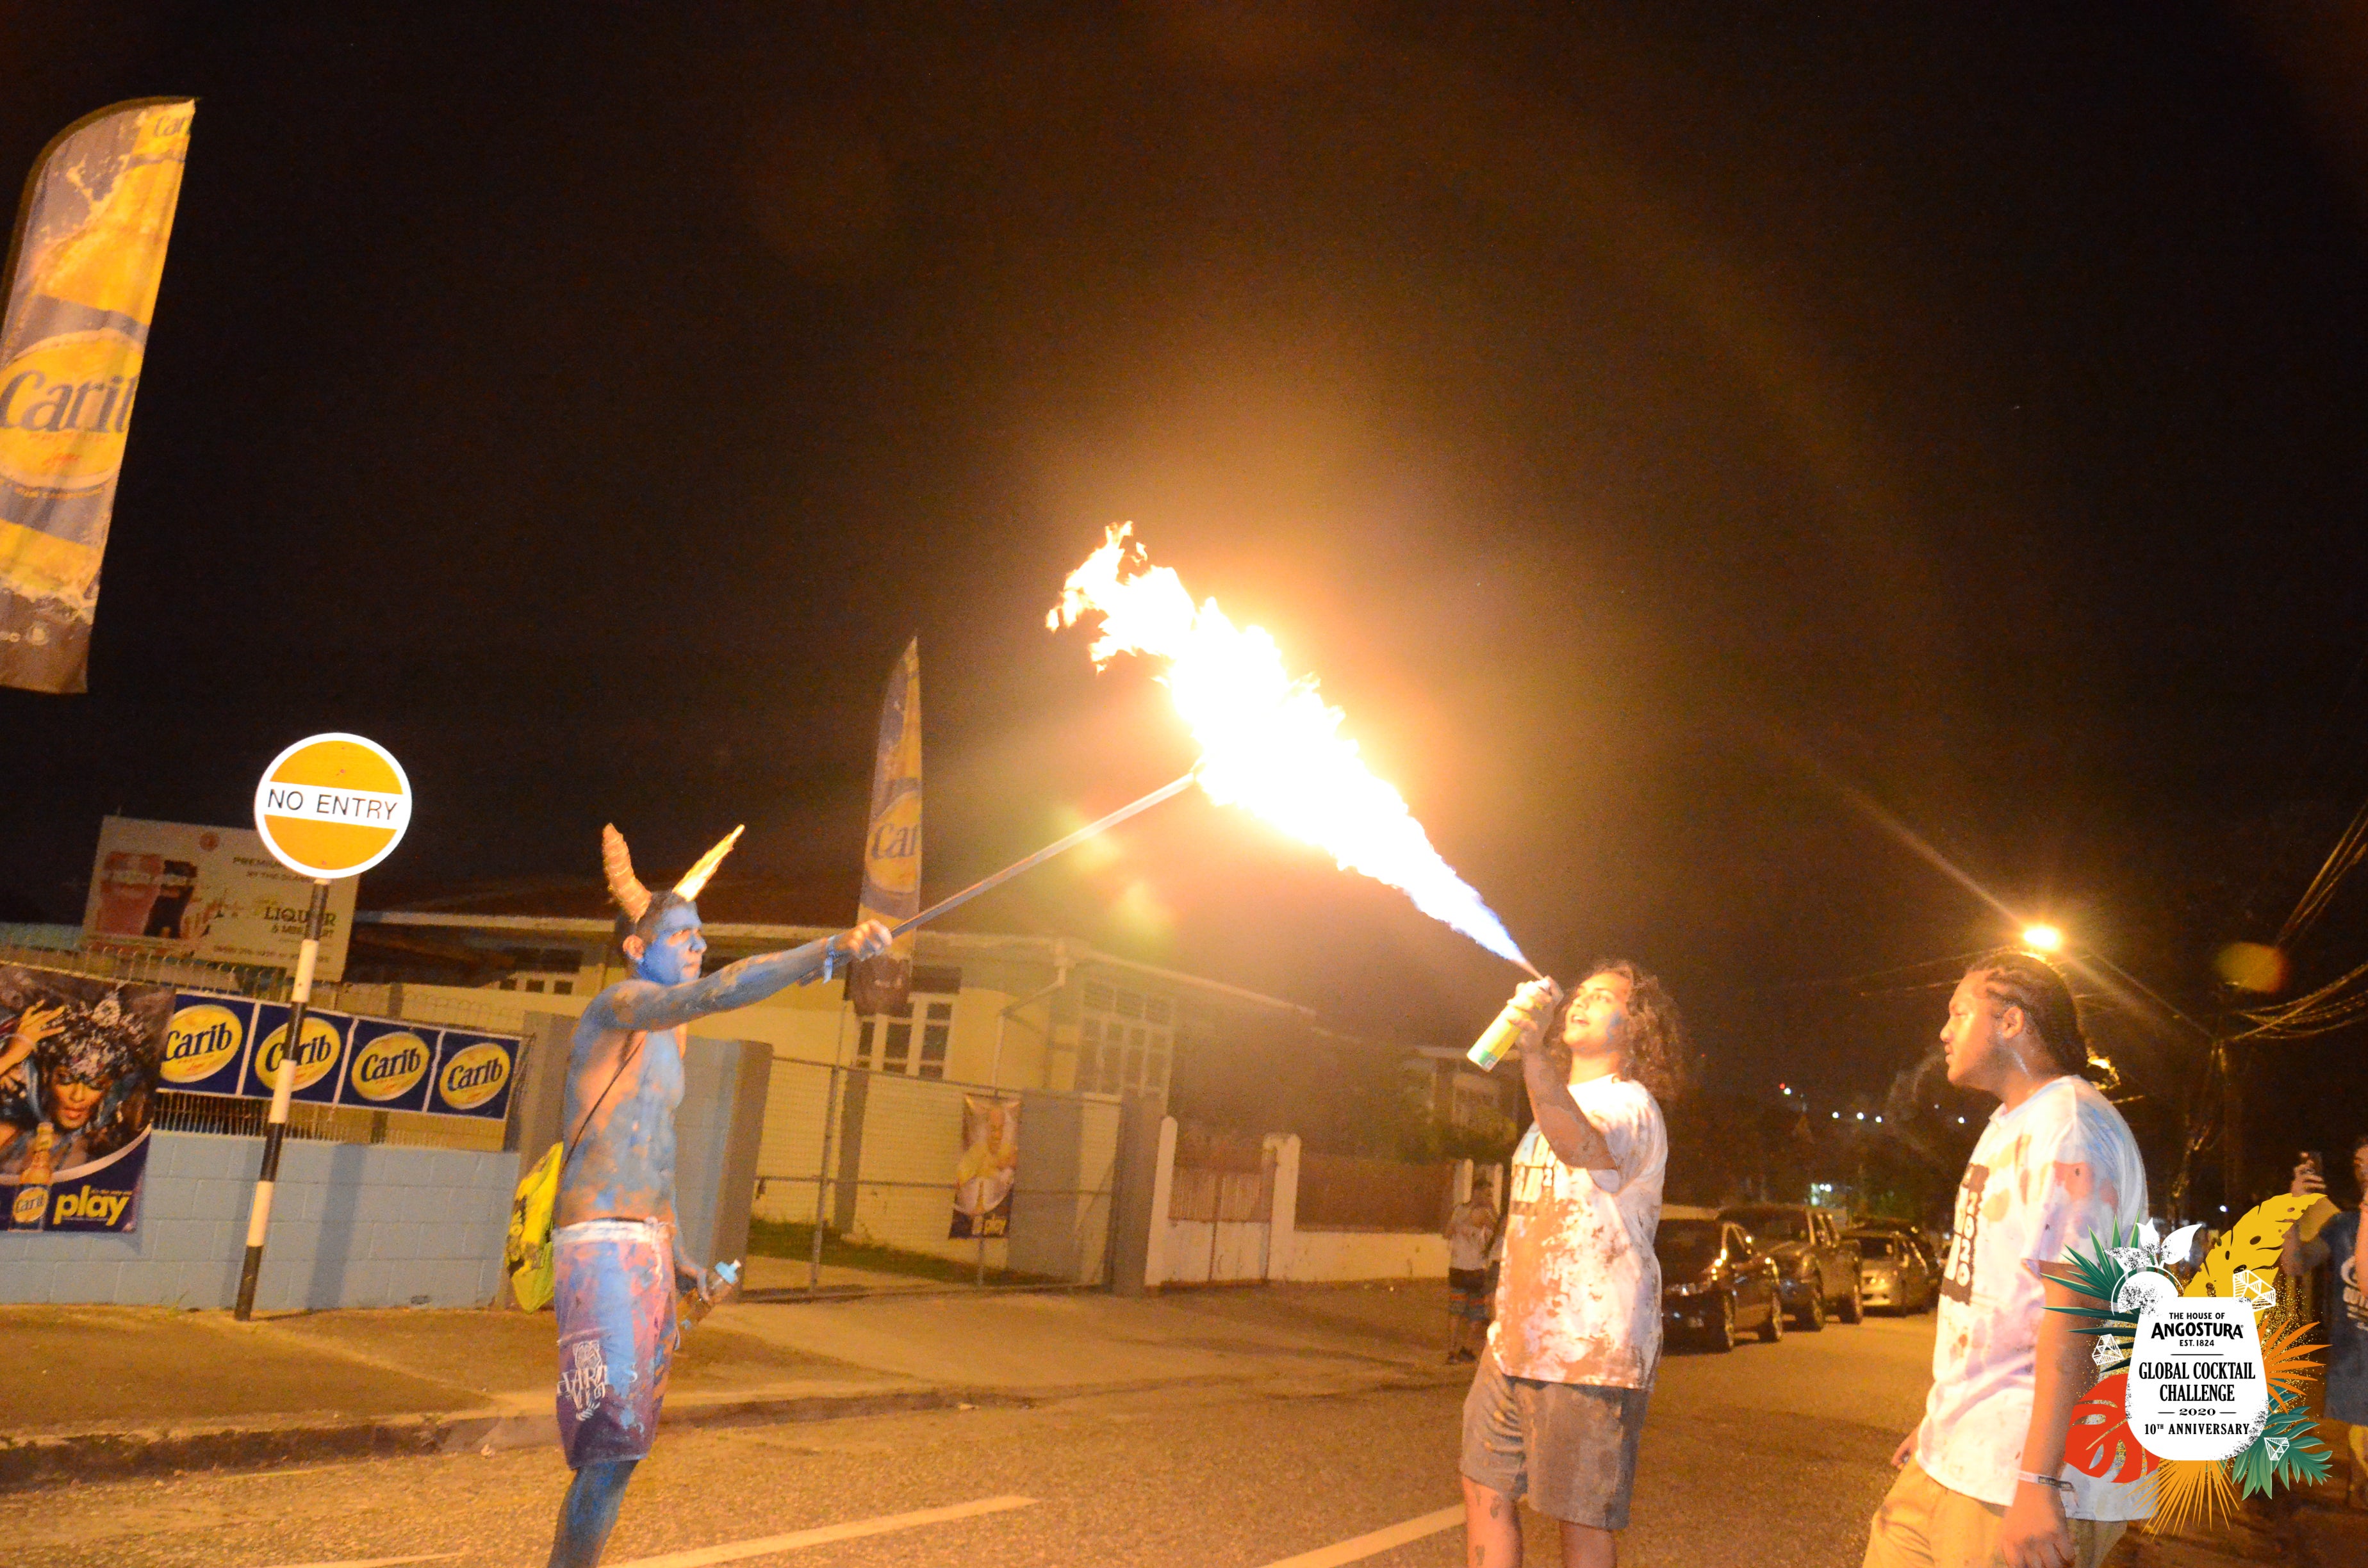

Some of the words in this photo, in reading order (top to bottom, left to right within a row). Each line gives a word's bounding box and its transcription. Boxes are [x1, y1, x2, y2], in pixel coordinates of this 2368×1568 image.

[268, 788, 303, 810] NO
[317, 794, 397, 820] ENTRY
[263, 906, 336, 926] LIQUR
[265, 1034, 331, 1072] Crib
[361, 1047, 422, 1082] Carib
[447, 1057, 503, 1091] Carib
[53, 1185, 131, 1226] play
